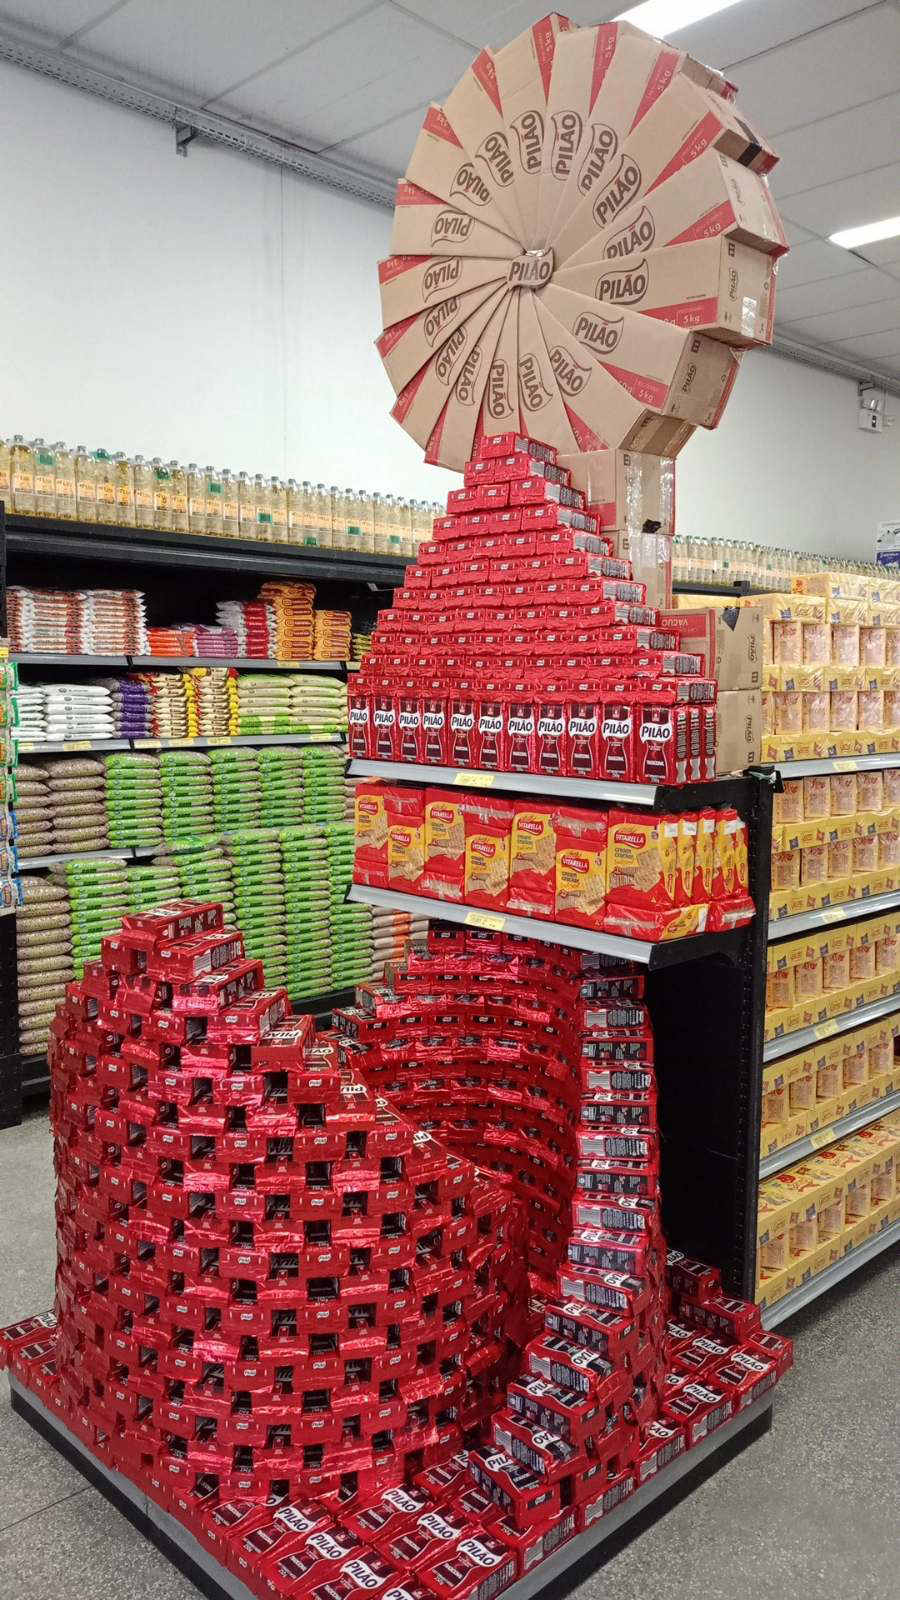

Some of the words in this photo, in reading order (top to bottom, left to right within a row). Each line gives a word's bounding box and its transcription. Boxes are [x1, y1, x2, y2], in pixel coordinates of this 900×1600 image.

[521, 113, 542, 169] PILÃO
[556, 114, 576, 175] PILÃO
[485, 137, 515, 183] PILÃO
[580, 130, 613, 191] PILÃO
[595, 166, 638, 225] PILÃO
[434, 218, 472, 238] PILÃO
[606, 222, 653, 259] PILÃO
[425, 261, 459, 290] PILÃO
[508, 261, 550, 281] PILÃO
[600, 273, 646, 300] PILÃO
[425, 299, 458, 336] PILÃO
[575, 317, 618, 349] PILÃO
[437, 327, 466, 378] PILÃO
[458, 350, 481, 401] PILÃO
[519, 357, 543, 409] PILÃO
[551, 350, 584, 392] PILÃO
[492, 364, 505, 417] PILÃO
[350, 711, 367, 723] PILÃO
[375, 712, 393, 723] PILÃO
[400, 714, 418, 726] PILÃO
[424, 715, 442, 726] PILÃO
[452, 716, 472, 728] PILÃO
[480, 718, 501, 730] PILÃO
[509, 719, 532, 732] PILÃO
[539, 721, 562, 733] PILÃO
[570, 721, 595, 733] PILÃO
[602, 722, 629, 735] PILÃO
[641, 725, 670, 739] PILÃO
[616, 834, 644, 844] VITARELLA
[735, 1355, 763, 1370] PILÃO
[688, 1386, 716, 1401] PILÃO
[387, 1490, 417, 1512] PILÃO
[278, 1508, 309, 1532] PILÃO
[421, 1514, 454, 1539] PILÃO
[311, 1534, 342, 1559] PILÃO
[461, 1540, 495, 1565] PILÃO
[345, 1561, 379, 1588] PILÃO
